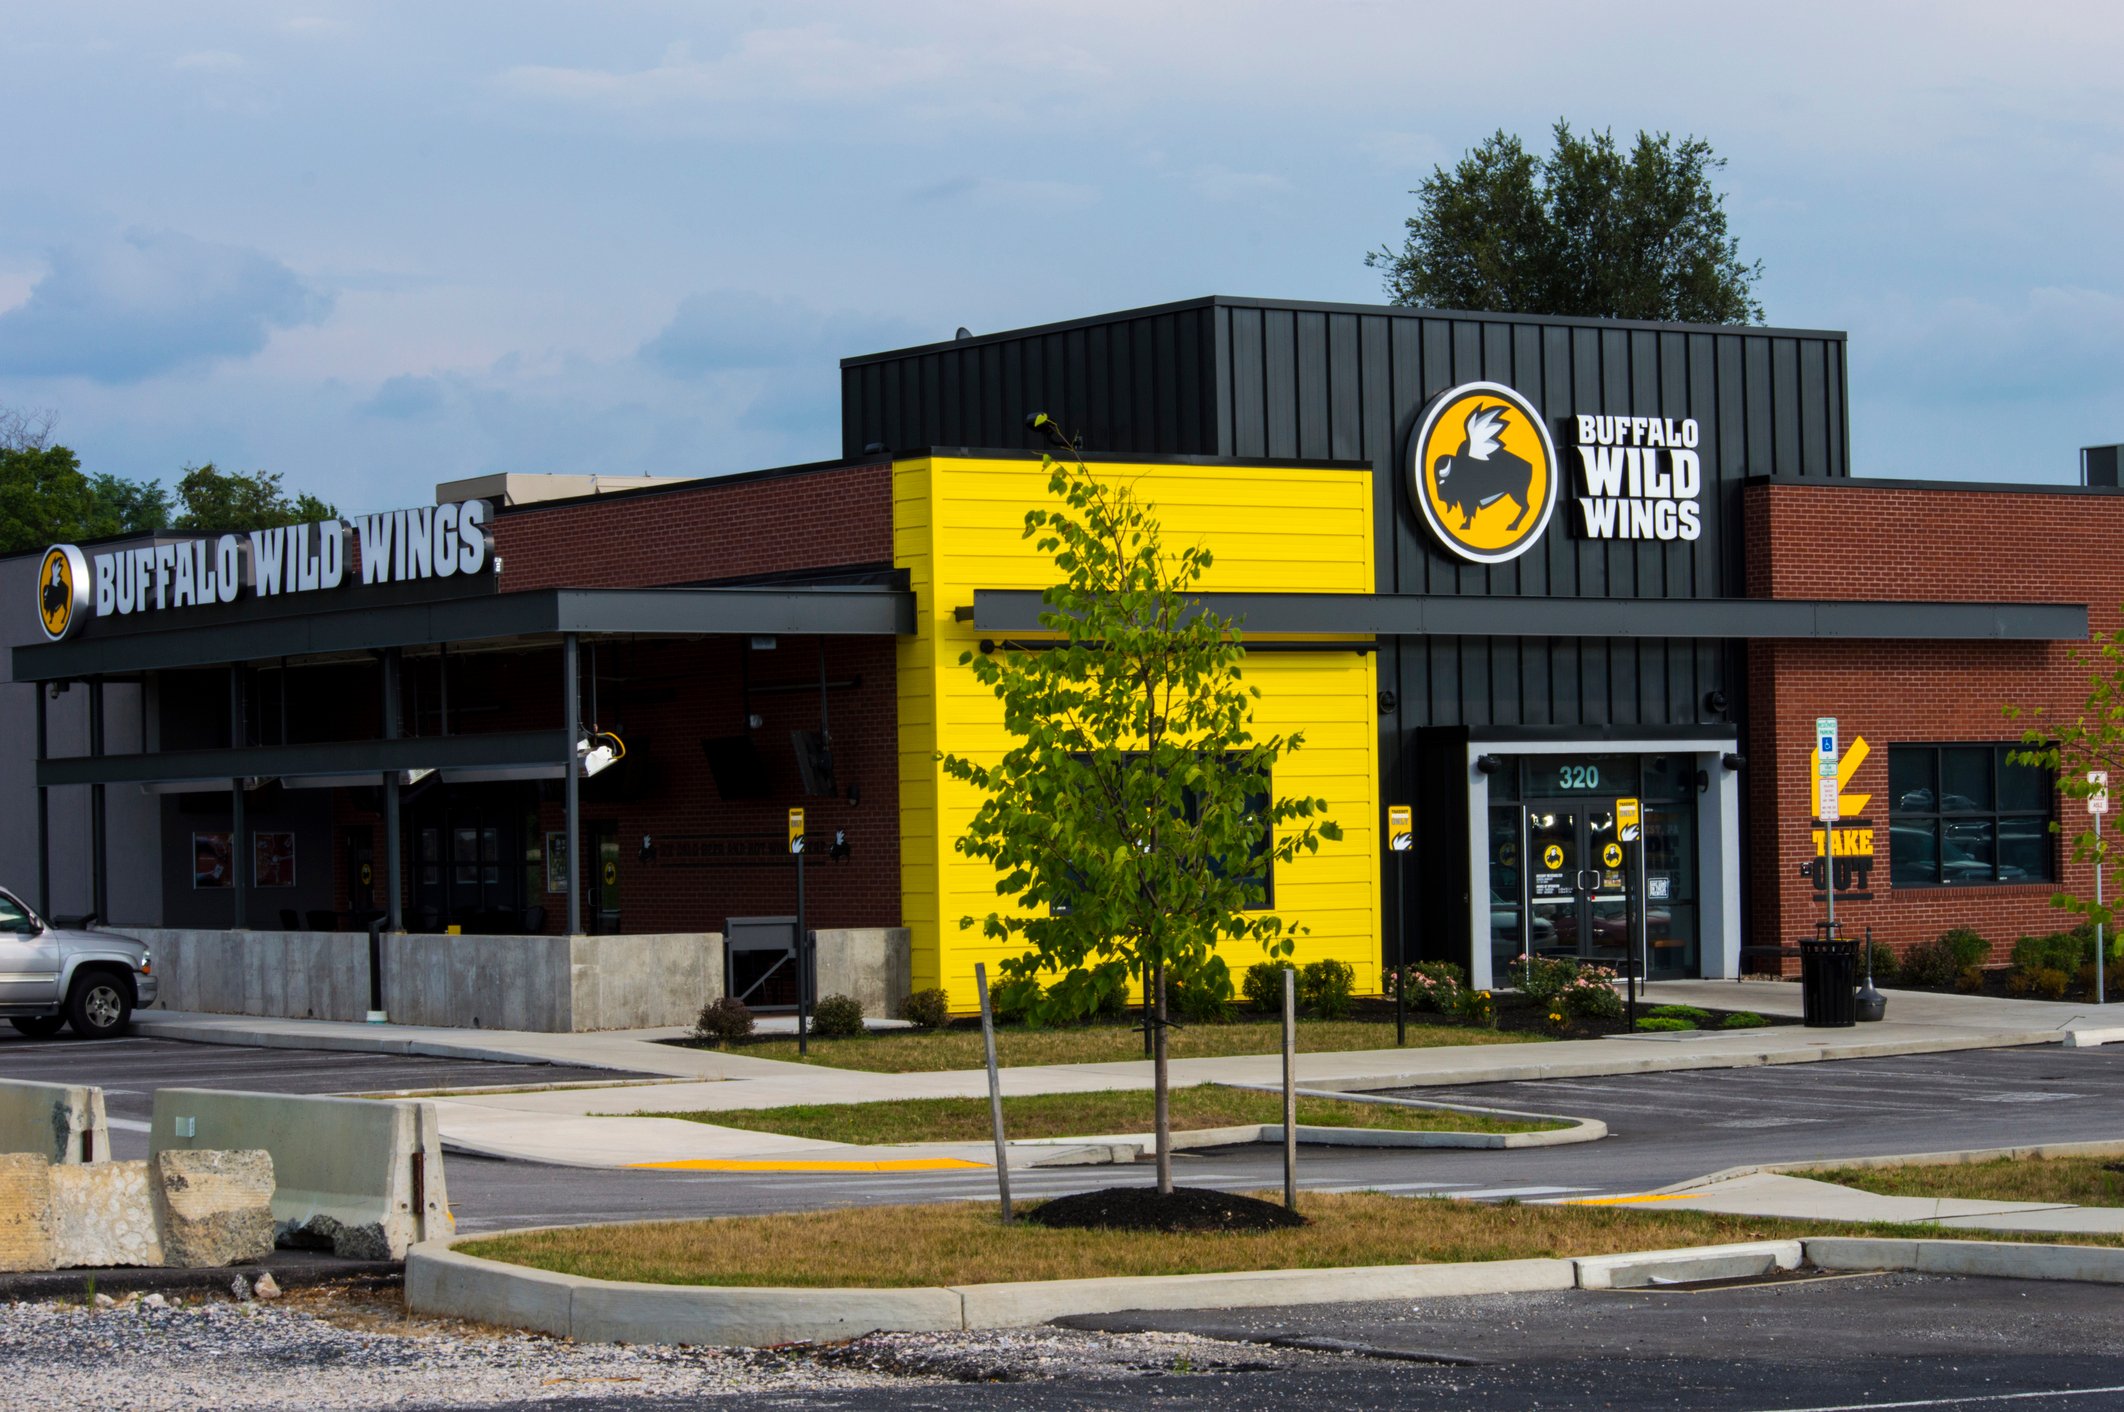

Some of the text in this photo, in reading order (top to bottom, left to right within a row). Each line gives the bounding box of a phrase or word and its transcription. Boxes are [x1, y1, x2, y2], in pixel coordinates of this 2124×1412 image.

[1576, 414, 1699, 448] BUFFALO
[1577, 446, 1701, 499] WILD
[1579, 498, 1701, 541] WINGS
[94, 500, 487, 617] BUFFALO WILD WINGS
[1559, 765, 1599, 789] 320
[1812, 829, 1874, 857] TAKE
[1813, 857, 1873, 890] OUT
